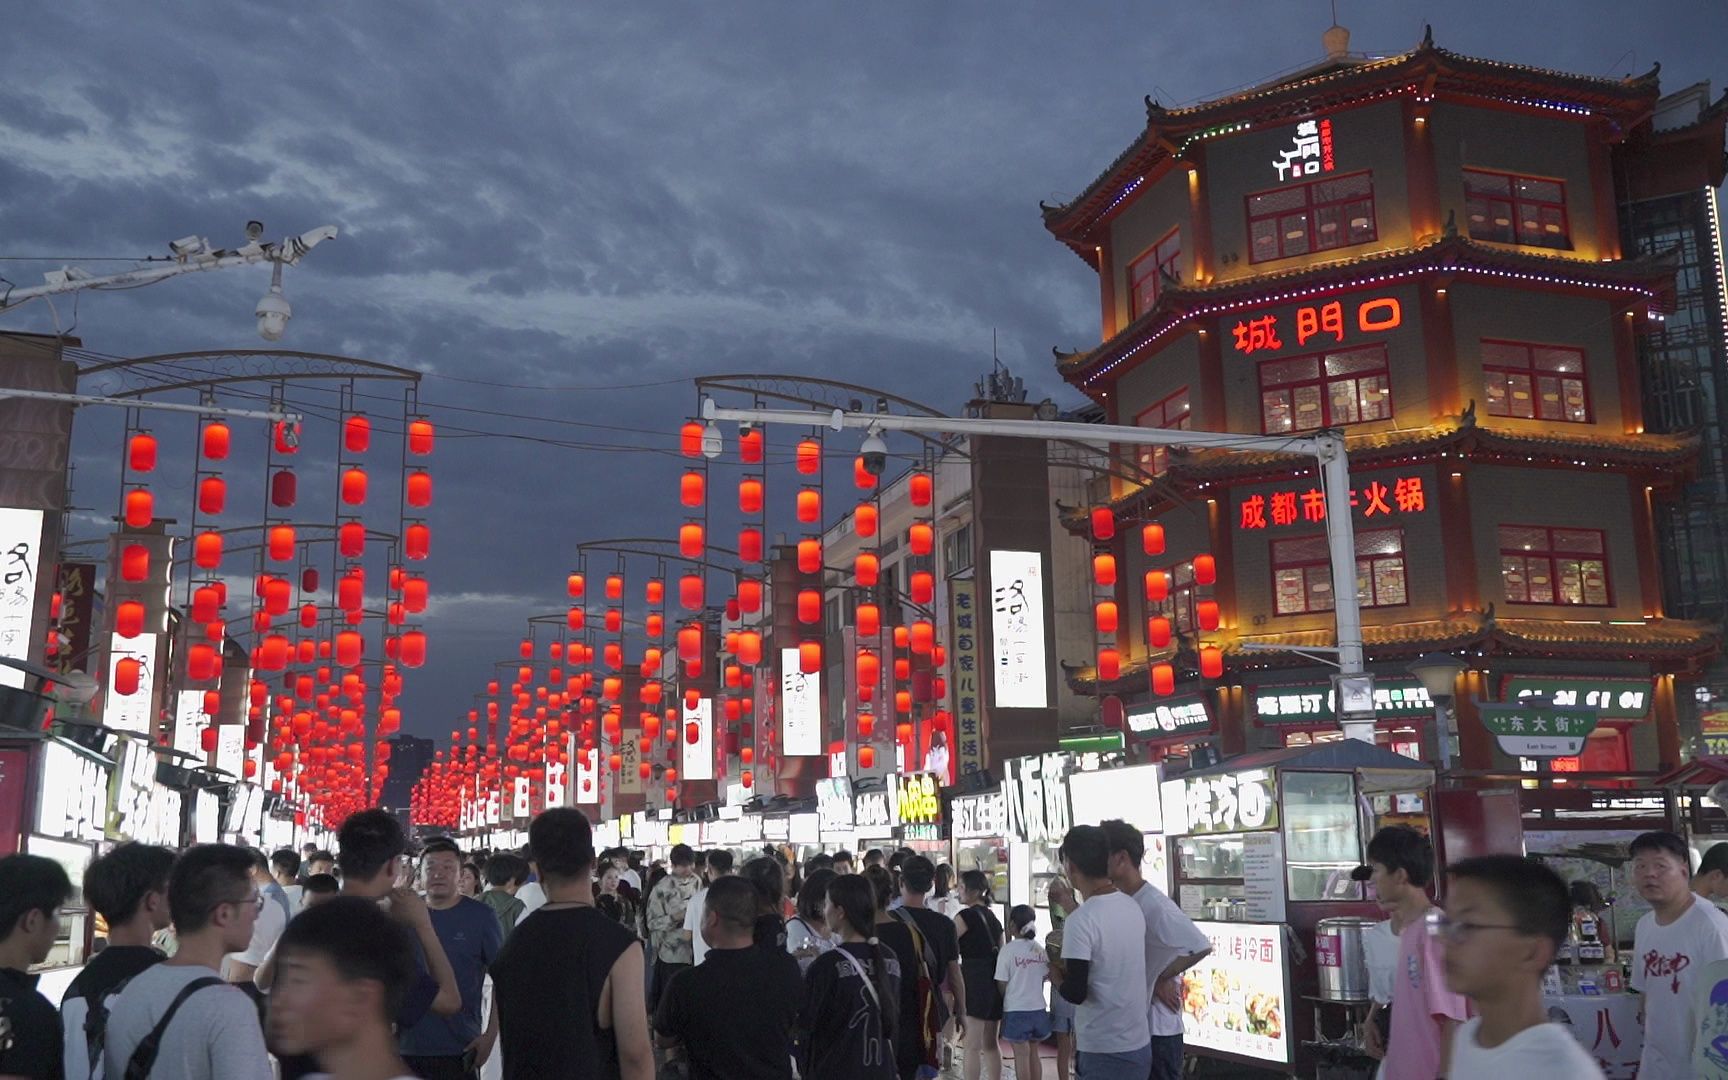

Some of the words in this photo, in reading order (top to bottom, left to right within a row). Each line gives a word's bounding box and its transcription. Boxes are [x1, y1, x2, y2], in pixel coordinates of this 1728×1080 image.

[1232, 298, 1401, 354] 城門口
[1240, 477, 1425, 529] 成都市火锅
[1510, 716, 1570, 733] 东大街
